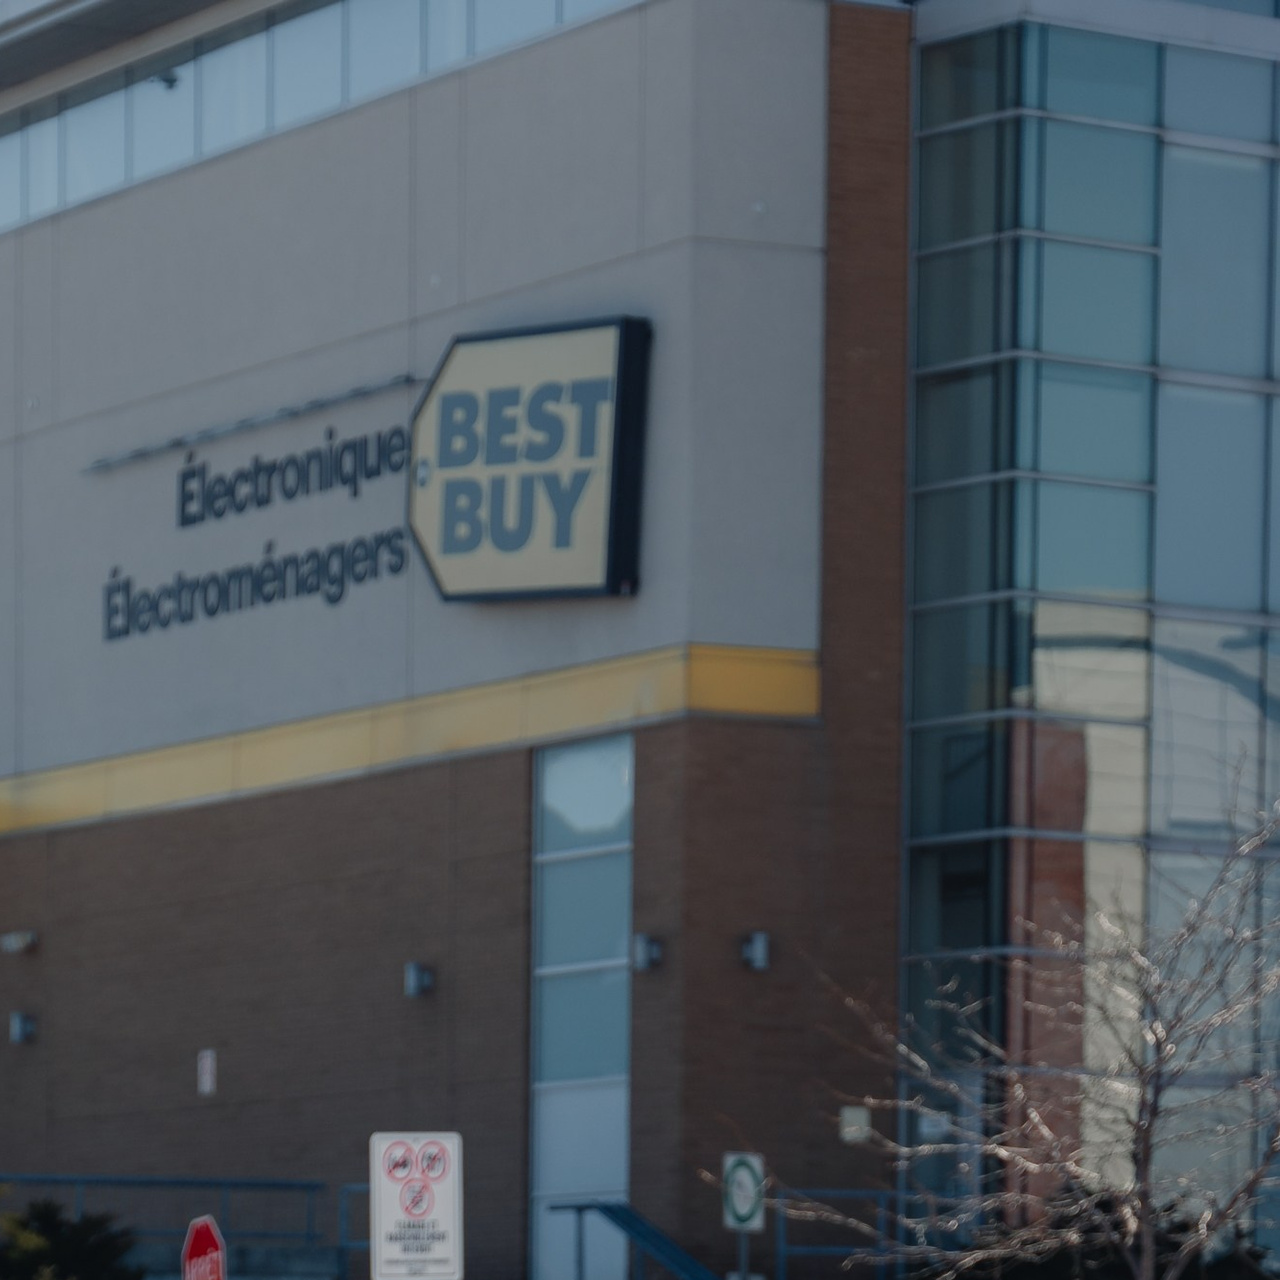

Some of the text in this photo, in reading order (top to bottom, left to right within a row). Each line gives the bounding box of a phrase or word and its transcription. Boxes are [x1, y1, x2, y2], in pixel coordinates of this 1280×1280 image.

[436, 376, 611, 470] BEST
[176, 423, 411, 529] Électronique
[440, 468, 591, 556] BUY
[102, 526, 408, 642] Électroménagers
